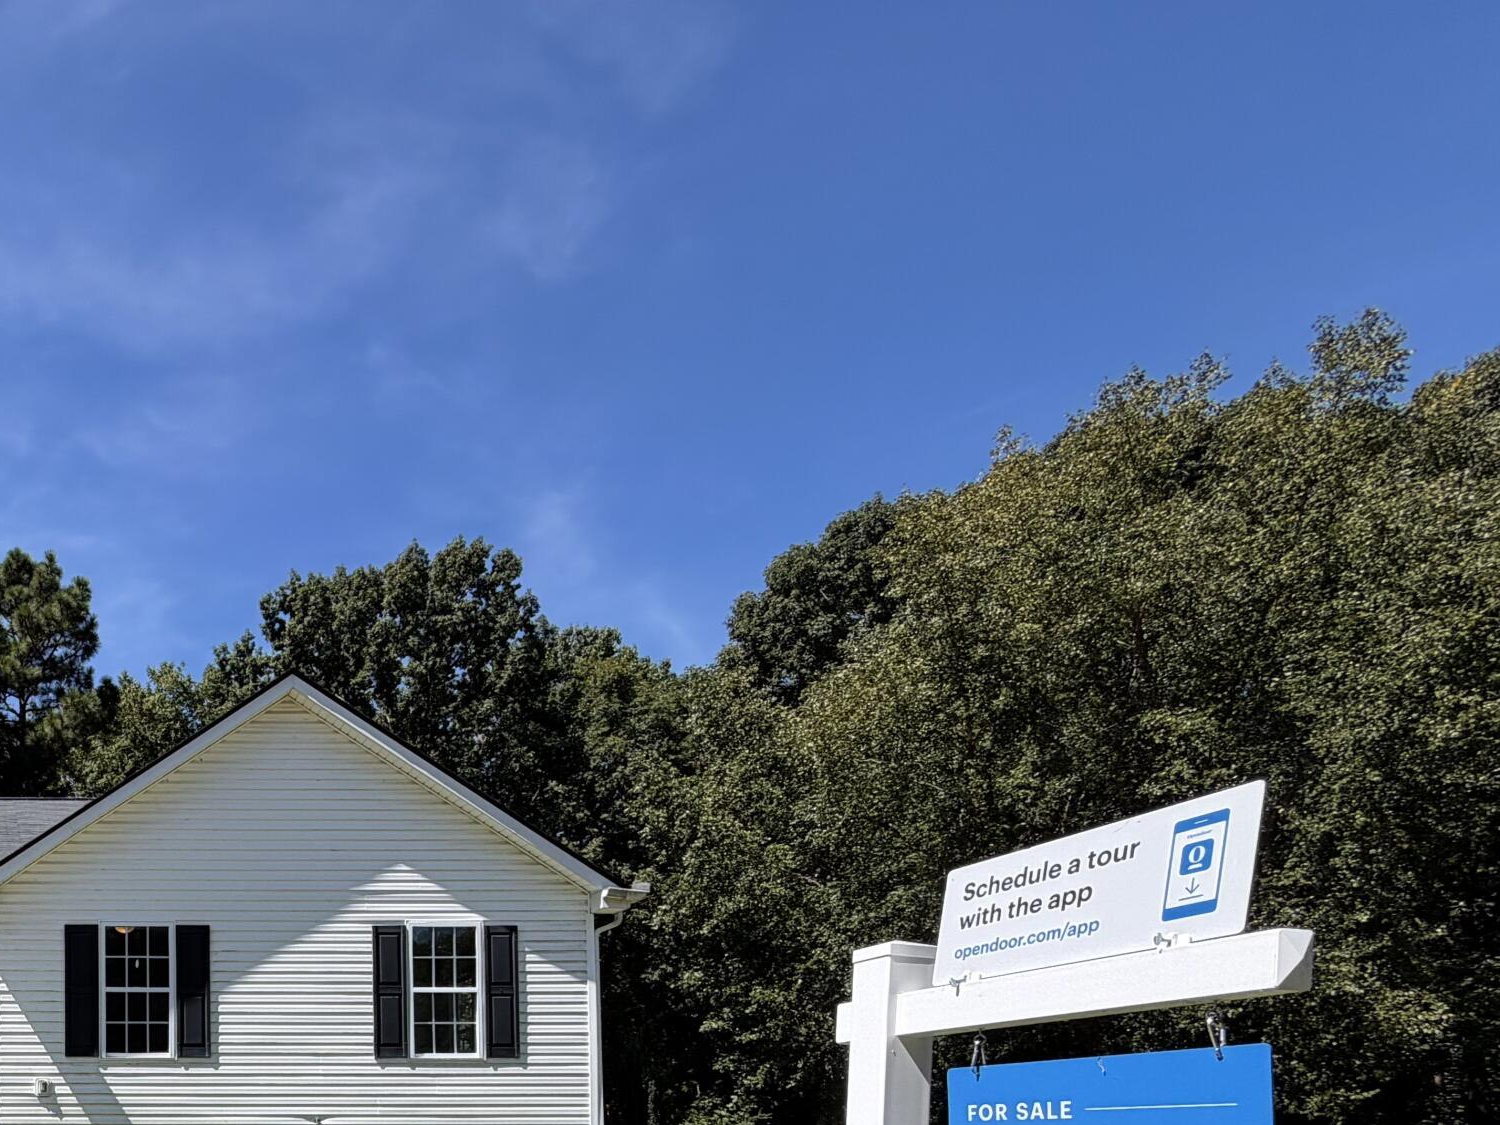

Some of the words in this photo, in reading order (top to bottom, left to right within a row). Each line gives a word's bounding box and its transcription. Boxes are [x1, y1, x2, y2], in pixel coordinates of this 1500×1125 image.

[962, 860, 1062, 902] Schedule
[1067, 857, 1082, 875] a
[1087, 840, 1141, 869] tour
[959, 903, 1001, 930] with
[1008, 896, 1042, 919] the
[1047, 885, 1093, 913] app
[954, 919, 1100, 961] opendoor.com/app
[967, 1103, 1008, 1122] FOR
[1016, 1100, 1073, 1121] SALE
